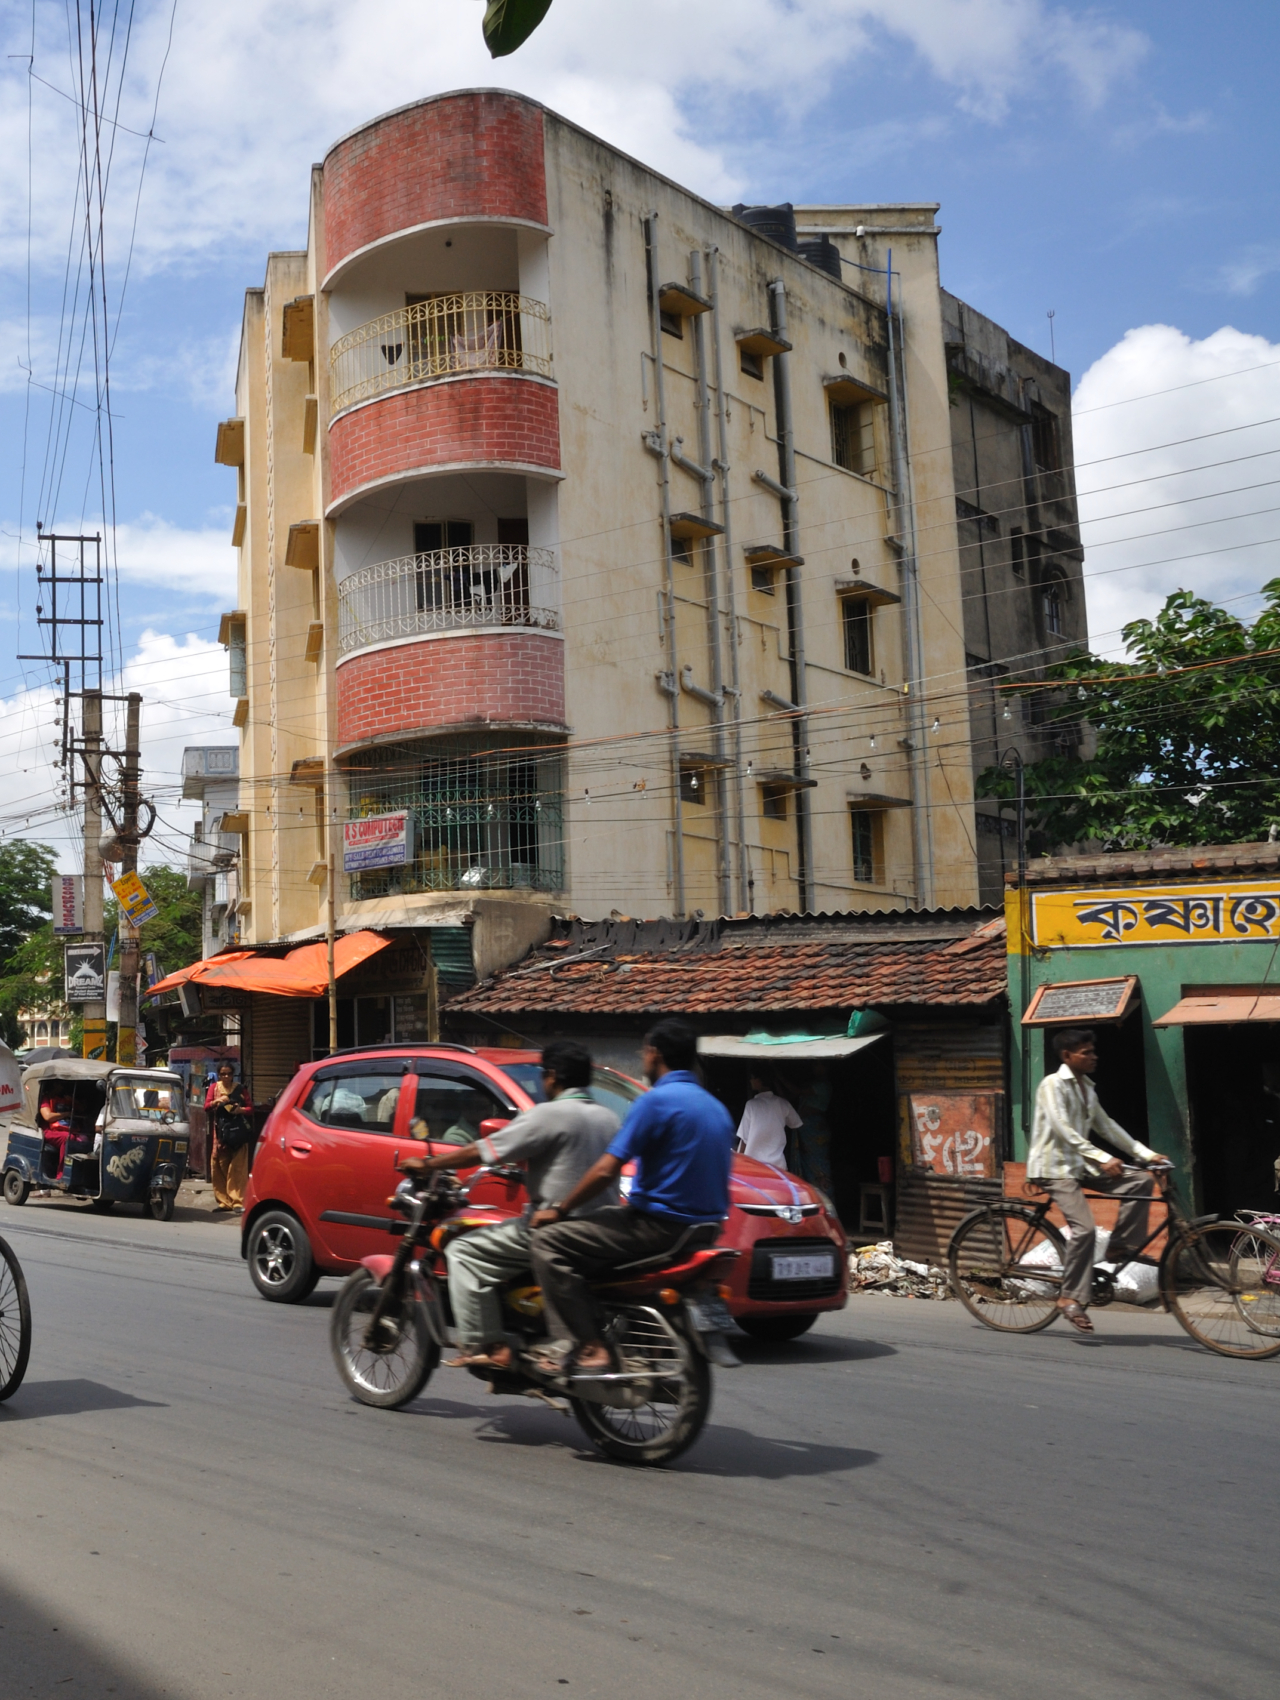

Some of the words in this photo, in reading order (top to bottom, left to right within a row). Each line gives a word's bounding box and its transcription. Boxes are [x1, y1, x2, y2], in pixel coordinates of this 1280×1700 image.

[345, 824, 351, 840] R
[352, 823, 357, 839] S
[1073, 893, 1227, 942] কৃষ্ণা
[68, 974, 104, 988] DREAMZ
